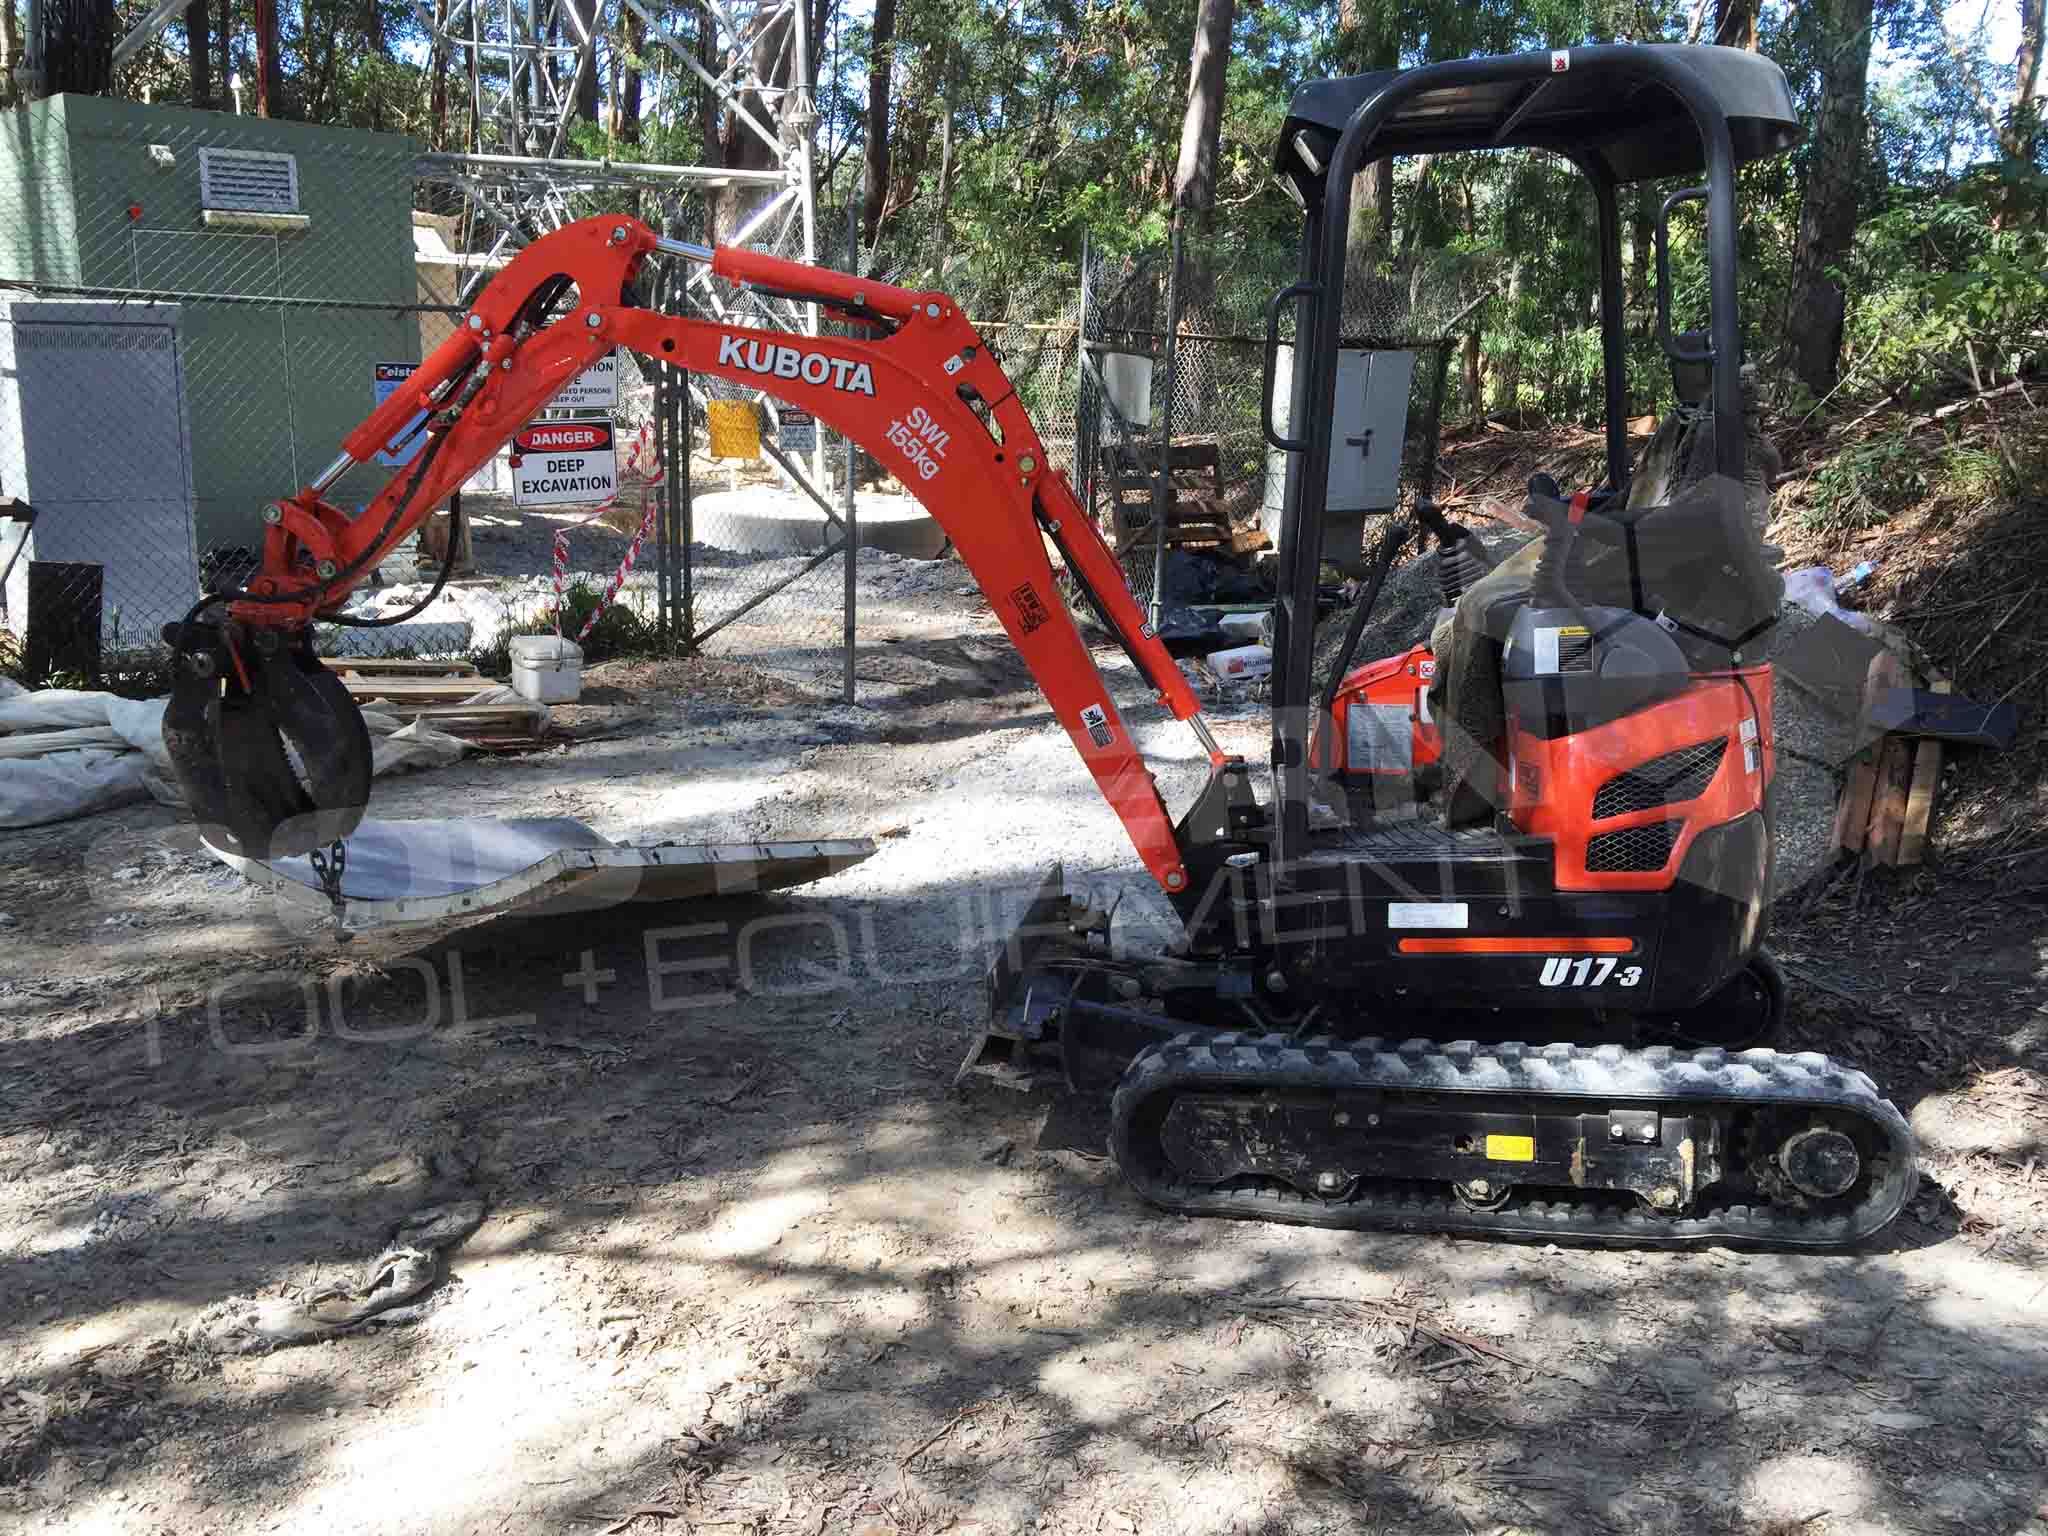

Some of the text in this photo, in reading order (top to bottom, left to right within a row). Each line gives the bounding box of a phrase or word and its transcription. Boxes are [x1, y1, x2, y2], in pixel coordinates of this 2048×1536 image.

[376, 365, 417, 378] Telstr
[718, 335, 876, 396] KUBOTA
[531, 431, 596, 446] DANGER
[907, 407, 950, 457] SWL
[884, 420, 941, 481] 155kg
[547, 458, 585, 473] DEEP
[522, 476, 611, 494] EXCAVATION
[1539, 957, 1642, 987] U17-3
